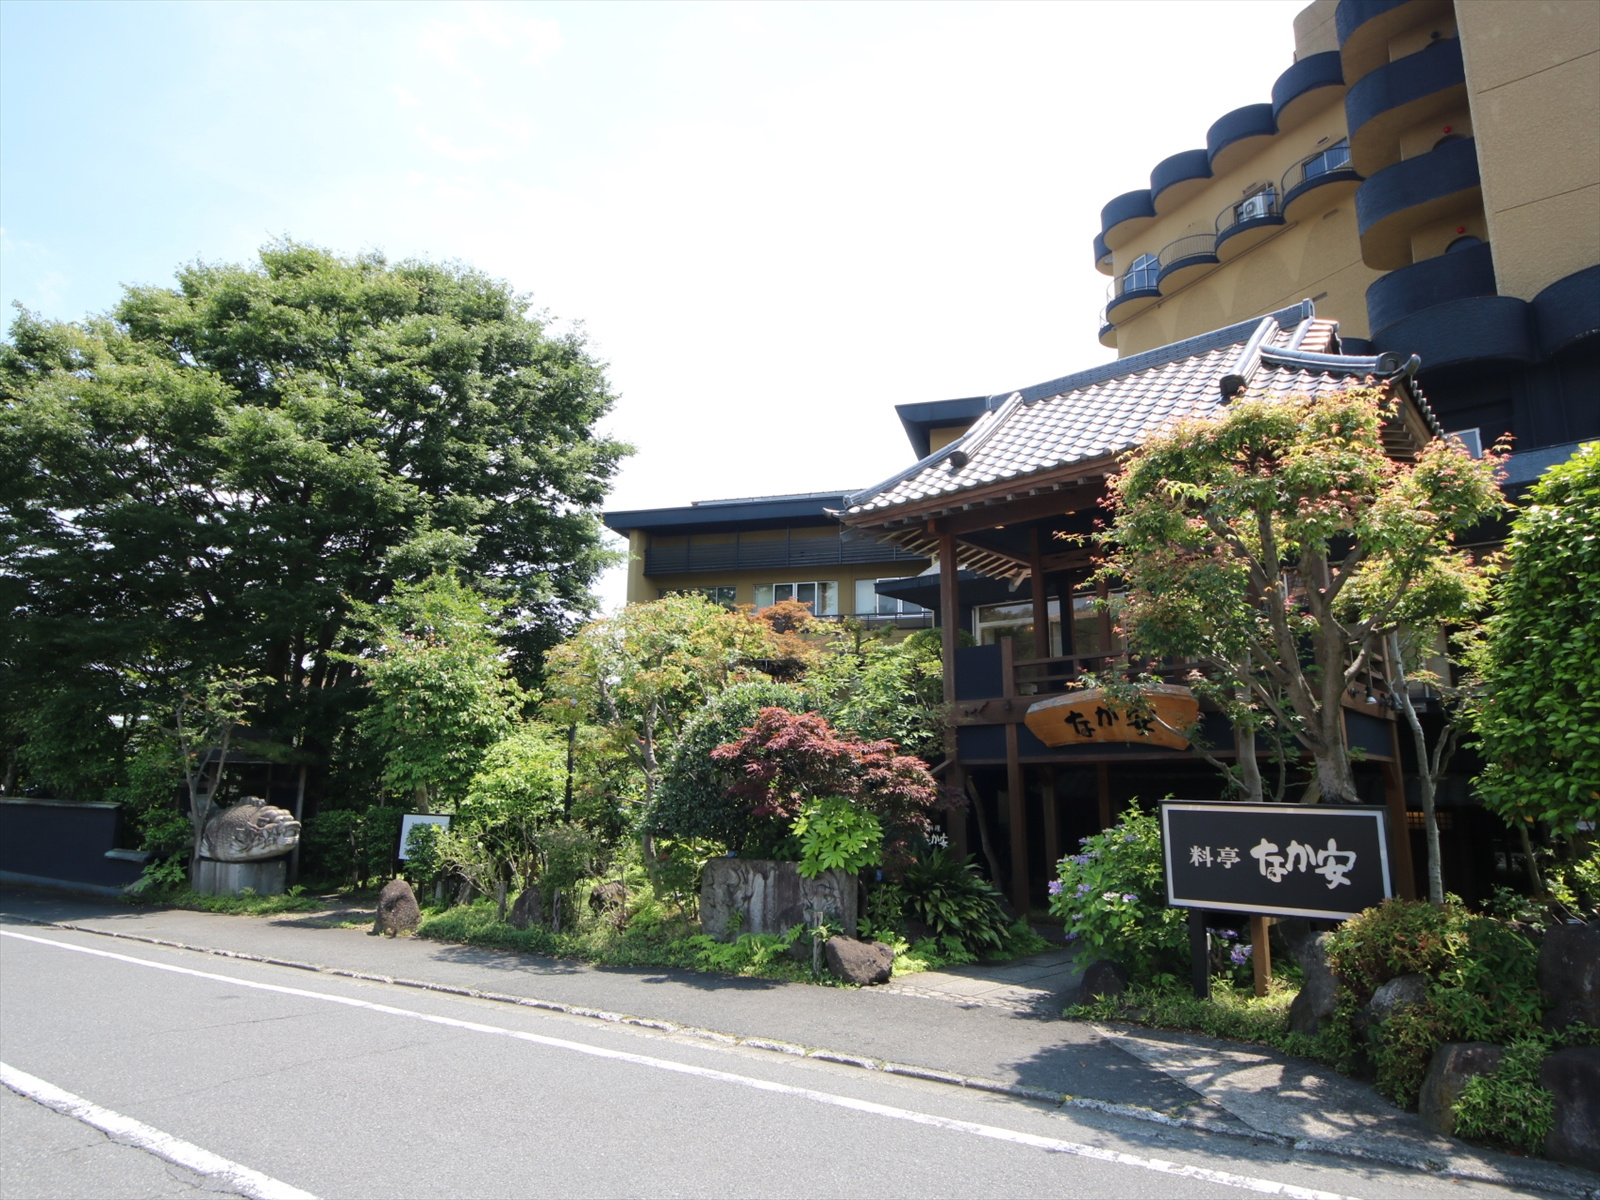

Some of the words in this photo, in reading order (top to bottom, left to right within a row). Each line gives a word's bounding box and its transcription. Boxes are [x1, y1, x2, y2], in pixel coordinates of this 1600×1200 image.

[1189, 845, 1241, 869] 料亭
[1250, 837, 1357, 890] なか安
